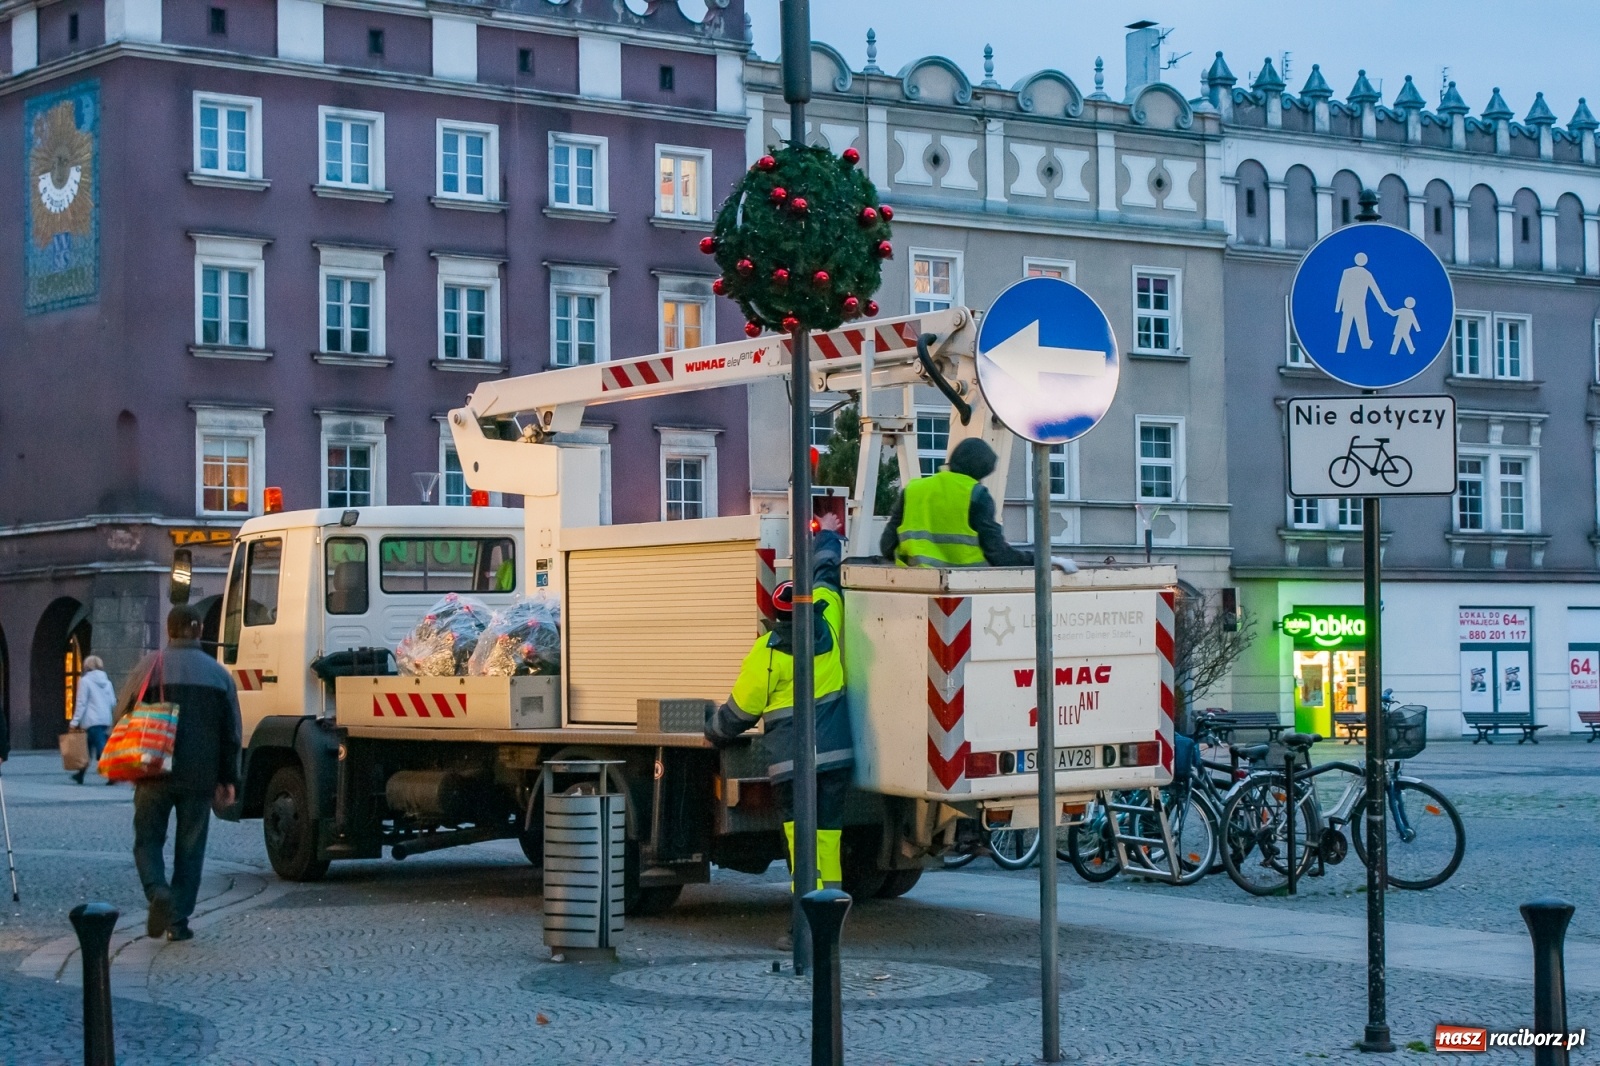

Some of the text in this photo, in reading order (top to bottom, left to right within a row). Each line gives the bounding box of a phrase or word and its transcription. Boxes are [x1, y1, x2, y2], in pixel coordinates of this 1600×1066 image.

[685, 358, 726, 373] WUMAG
[1295, 404, 1446, 430] Nie dotyczy
[1022, 610, 1145, 629] LEUNGSPARTNER
[1469, 630, 1487, 640] 880
[1489, 630, 1506, 640] 201
[1510, 630, 1527, 640] 117
[1013, 665, 1112, 688] WMAG
[1058, 690, 1100, 726] ELEVANT
[1058, 748, 1092, 768] AV28
